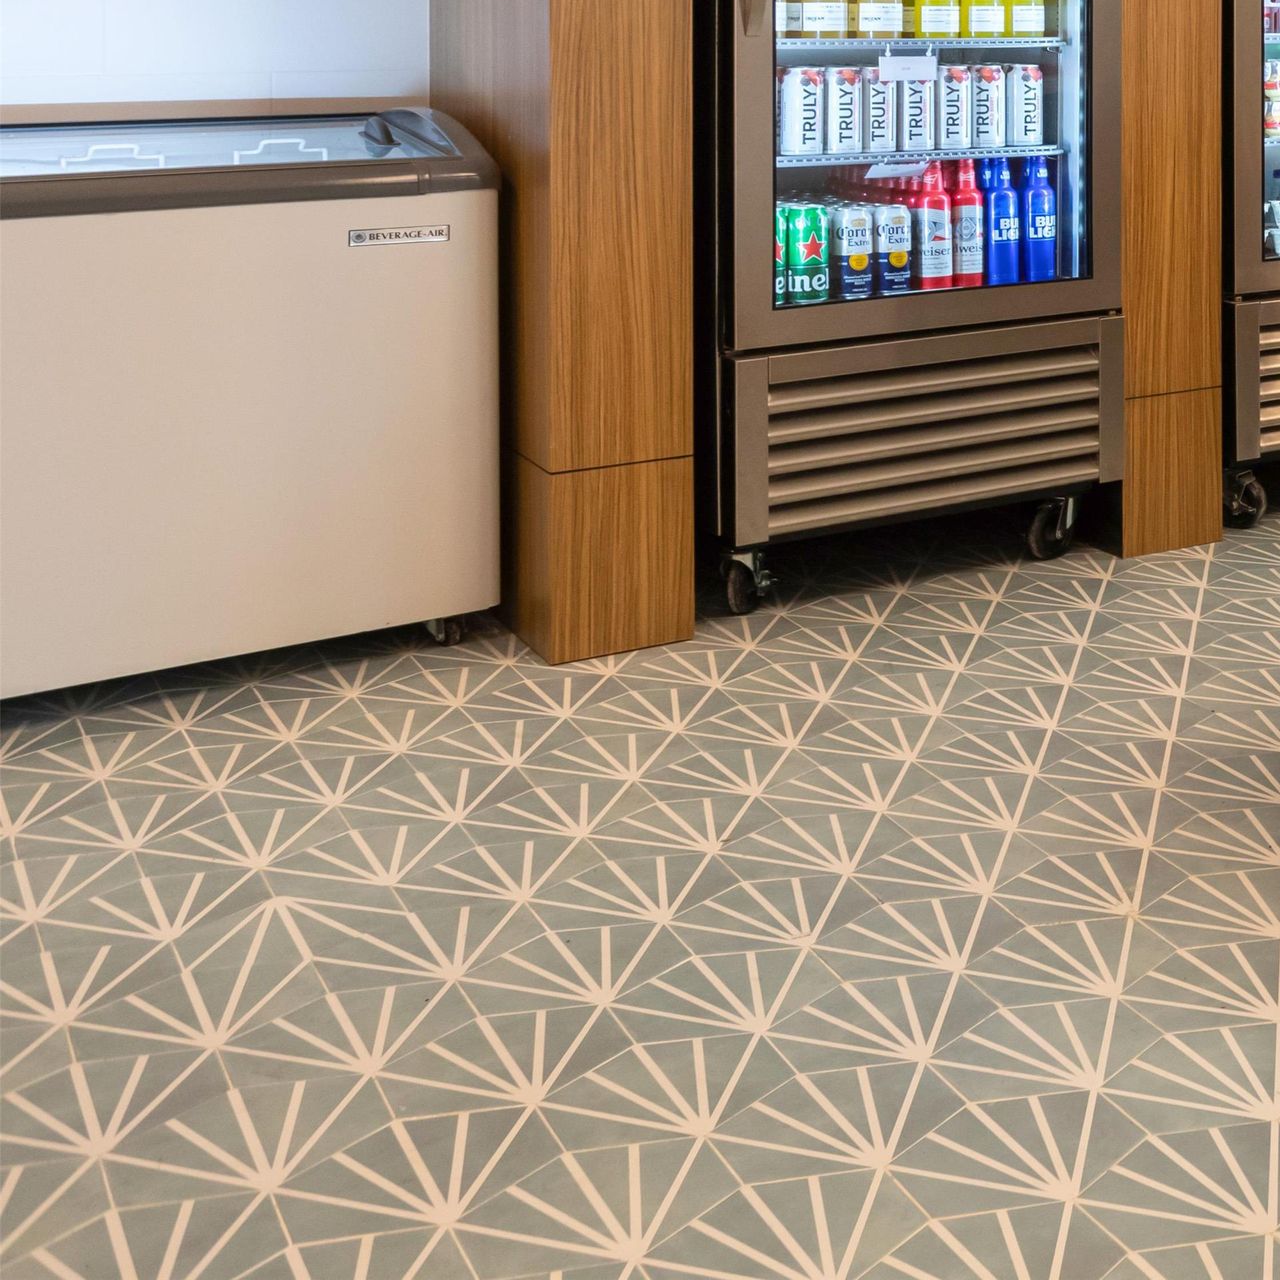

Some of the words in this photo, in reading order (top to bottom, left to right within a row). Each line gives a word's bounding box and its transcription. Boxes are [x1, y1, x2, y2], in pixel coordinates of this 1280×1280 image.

[802, 88, 817, 145] TRULY
[839, 87, 853, 143] TRULY
[871, 87, 886, 142] TRULY
[909, 86, 923, 141] TRULY
[946, 84, 960, 139] TRULY
[976, 84, 990, 138] TRULY
[1024, 83, 1037, 136] TRULY
[368, 229, 445, 241] BEVERAGE-AIR
